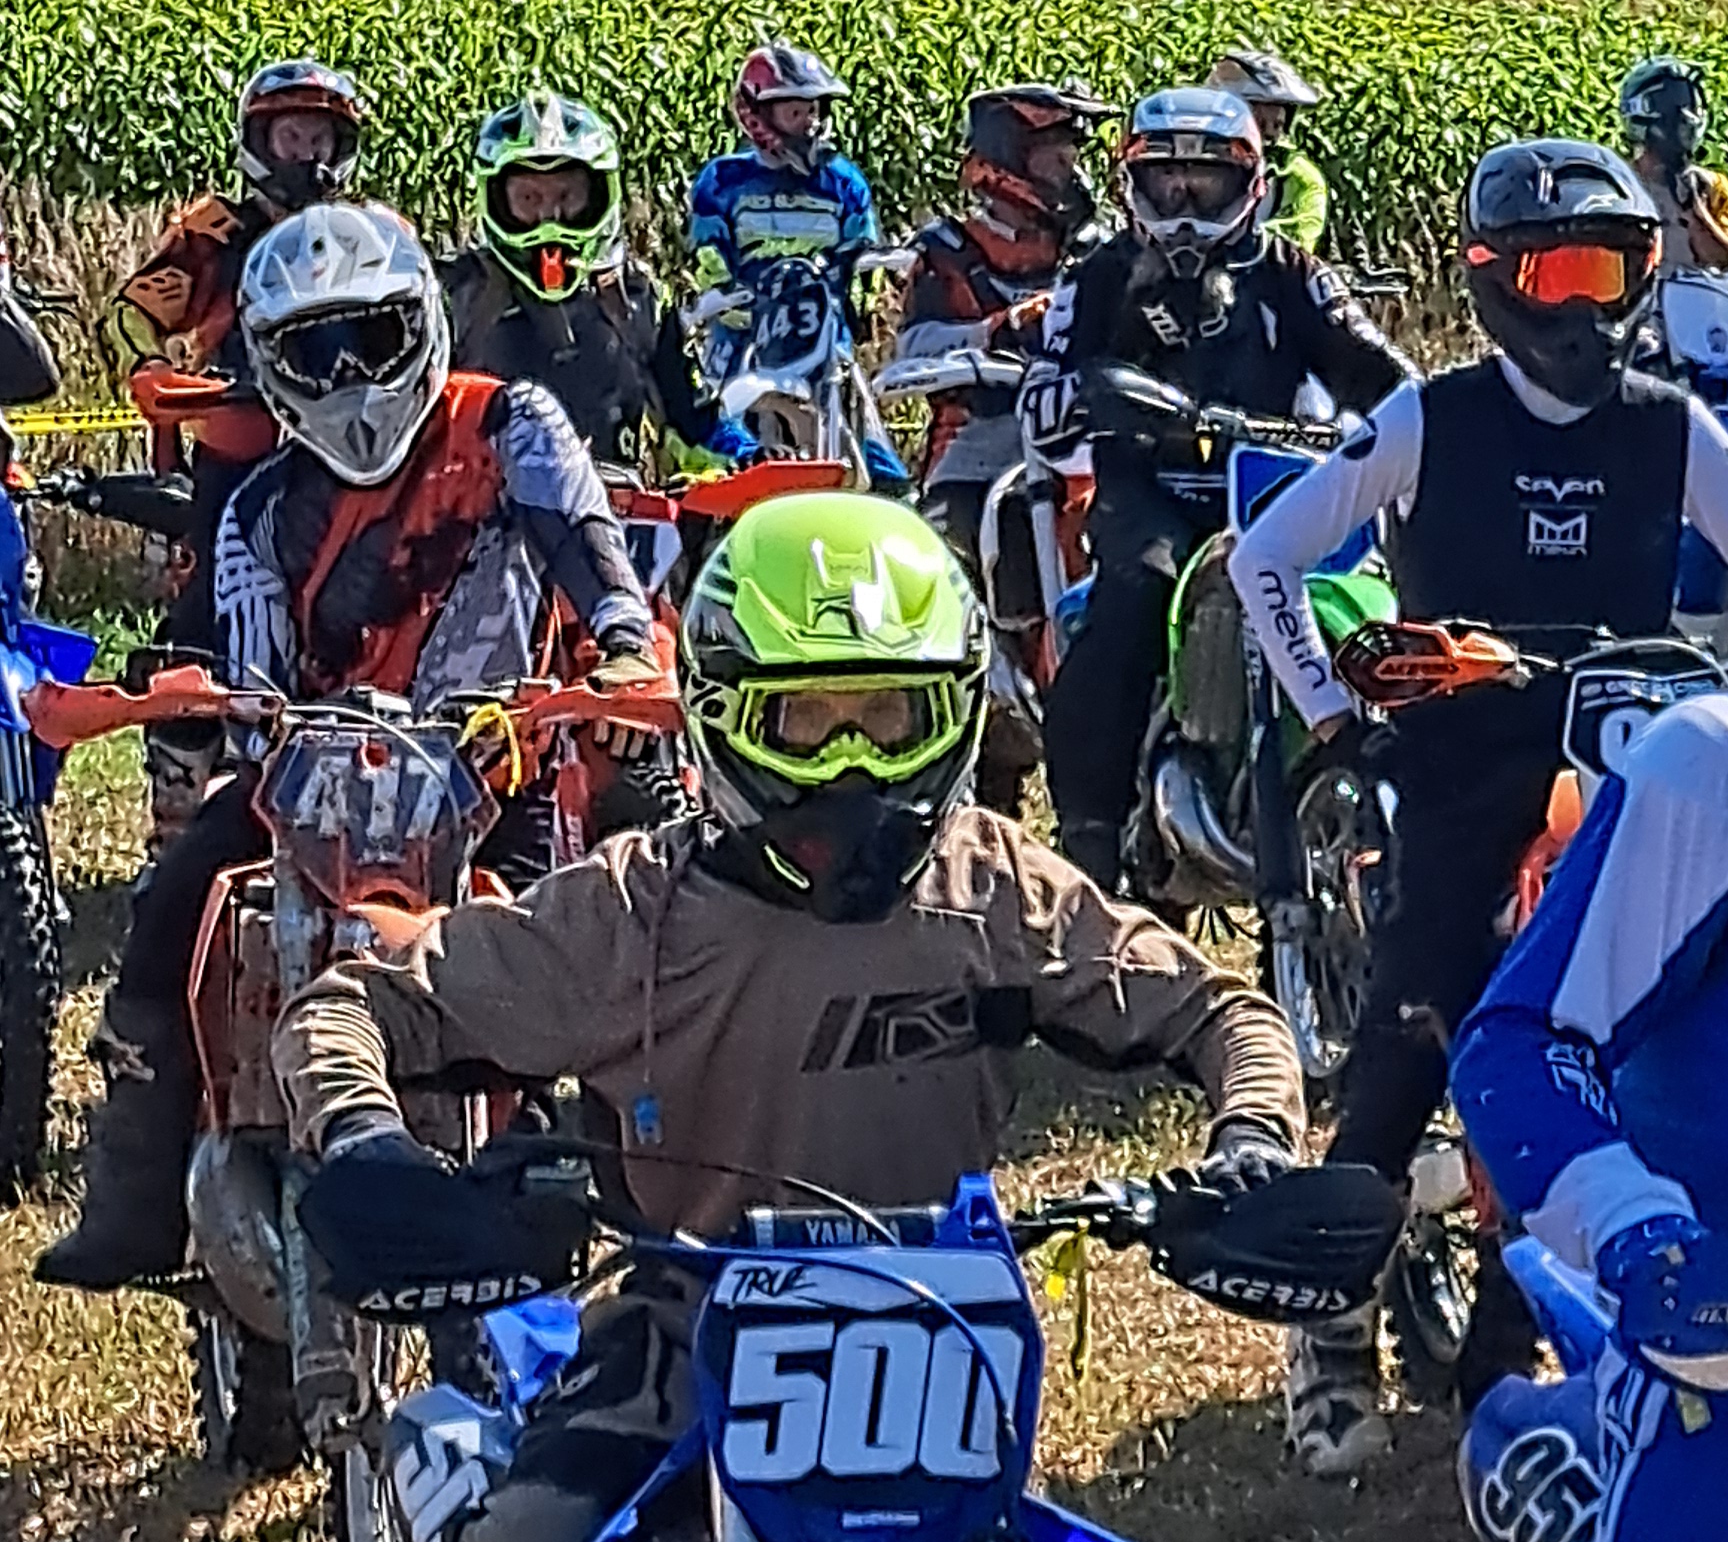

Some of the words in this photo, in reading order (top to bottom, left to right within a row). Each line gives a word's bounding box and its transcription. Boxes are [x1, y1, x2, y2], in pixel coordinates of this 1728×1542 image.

[1257, 570, 1328, 691] melin
[805, 1218, 901, 1246] YAMAA
[358, 1274, 542, 1310] ACERBIS
[1186, 1268, 1351, 1311] ACERBIS
[723, 1320, 1025, 1481] 500
